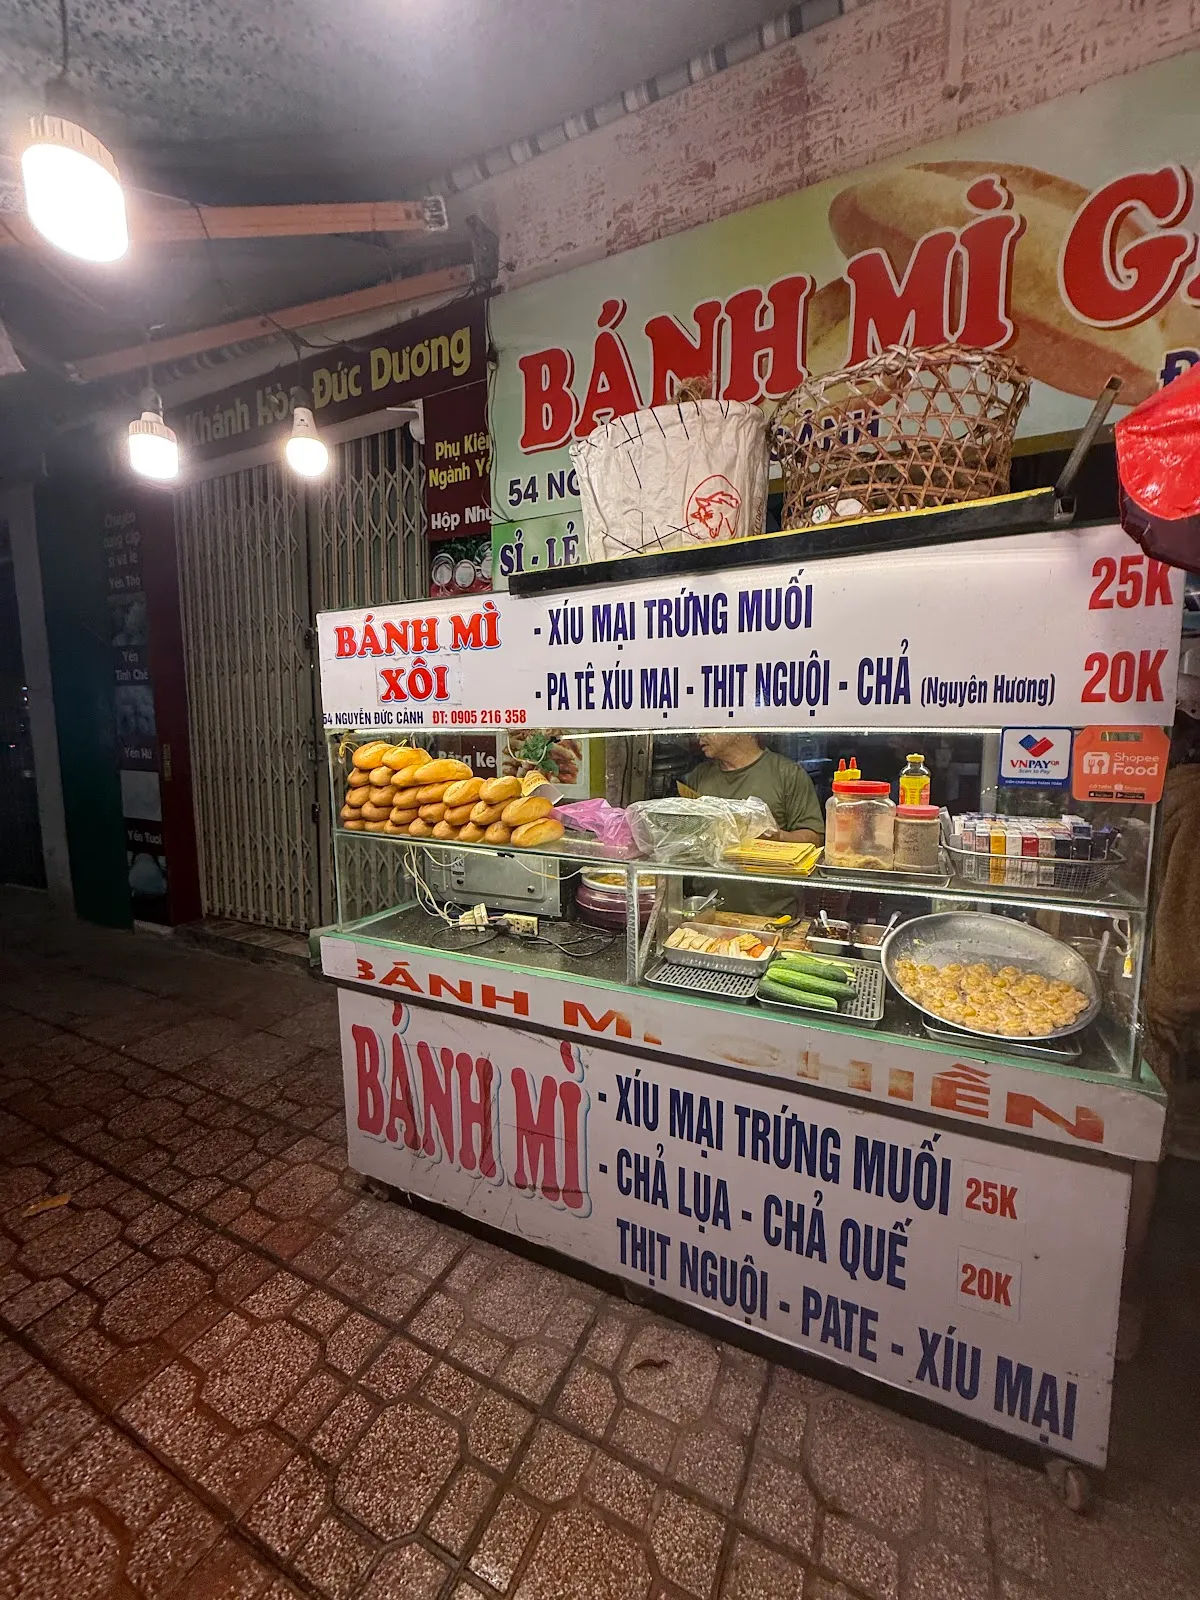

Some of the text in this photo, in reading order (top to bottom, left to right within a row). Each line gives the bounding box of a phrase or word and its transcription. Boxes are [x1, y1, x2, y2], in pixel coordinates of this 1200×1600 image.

[517, 165, 1200, 452] BÁNH MÌ G
[185, 398, 250, 444] Khánh
[312, 361, 362, 409] Đức
[370, 326, 471, 391] Dương
[435, 439, 460, 461] Phụ
[429, 461, 470, 490] Ngành
[508, 475, 539, 507] 54
[547, 469, 580, 501] NG
[431, 511, 460, 531] Hộp
[500, 529, 524, 576] SỈ
[546, 521, 580, 568] LẺ
[1088, 554, 1174, 610] 25K
[334, 601, 502, 659] BÁNH MÌ
[548, 599, 584, 646] XÍU
[592, 602, 636, 650] MẠI
[643, 587, 728, 640] TRỨNG
[738, 569, 813, 633] MUỐI
[379, 656, 450, 703] XÔI
[547, 672, 570, 711] PA
[574, 662, 595, 710] TÊ
[601, 660, 633, 710] XÍU
[640, 667, 679, 718] MẠI
[701, 663, 748, 718] THỊT
[755, 650, 830, 717] NGUỘI
[857, 638, 911, 706] CHẢ
[920, 674, 988, 708] (Nguyên
[993, 673, 1056, 707] Hương)
[1080, 649, 1169, 704] 20K
[335, 708, 372, 725] NGUYỄN
[374, 709, 393, 724] ĐỨC
[396, 707, 424, 724] CẢNH
[433, 709, 527, 725] ĐT: 0905 216 358
[476, 752, 498, 768] Ke
[1010, 759, 1051, 769] VNPAY
[1113, 763, 1158, 776] Food
[1115, 752, 1160, 763] Shopee
[351, 1000, 588, 1210] BÁNH MÌ
[616, 1068, 659, 1131] XÍU
[669, 1088, 724, 1158] MẠI
[734, 1104, 841, 1185] TRỨNG
[853, 1133, 952, 1216] MUỐI
[616, 1143, 669, 1210] CHẢ
[678, 1166, 732, 1233] LỤA
[764, 1190, 827, 1264] CHẢ
[839, 1218, 912, 1290] QUẾ
[965, 1177, 1018, 1220] 25K
[960, 1263, 1012, 1307] 20K
[616, 1218, 671, 1286] THỊT
[680, 1241, 768, 1324] NGUỘI
[801, 1285, 879, 1363] PATE
[916, 1325, 982, 1400] XÍU
[994, 1355, 1077, 1444] MẠI
